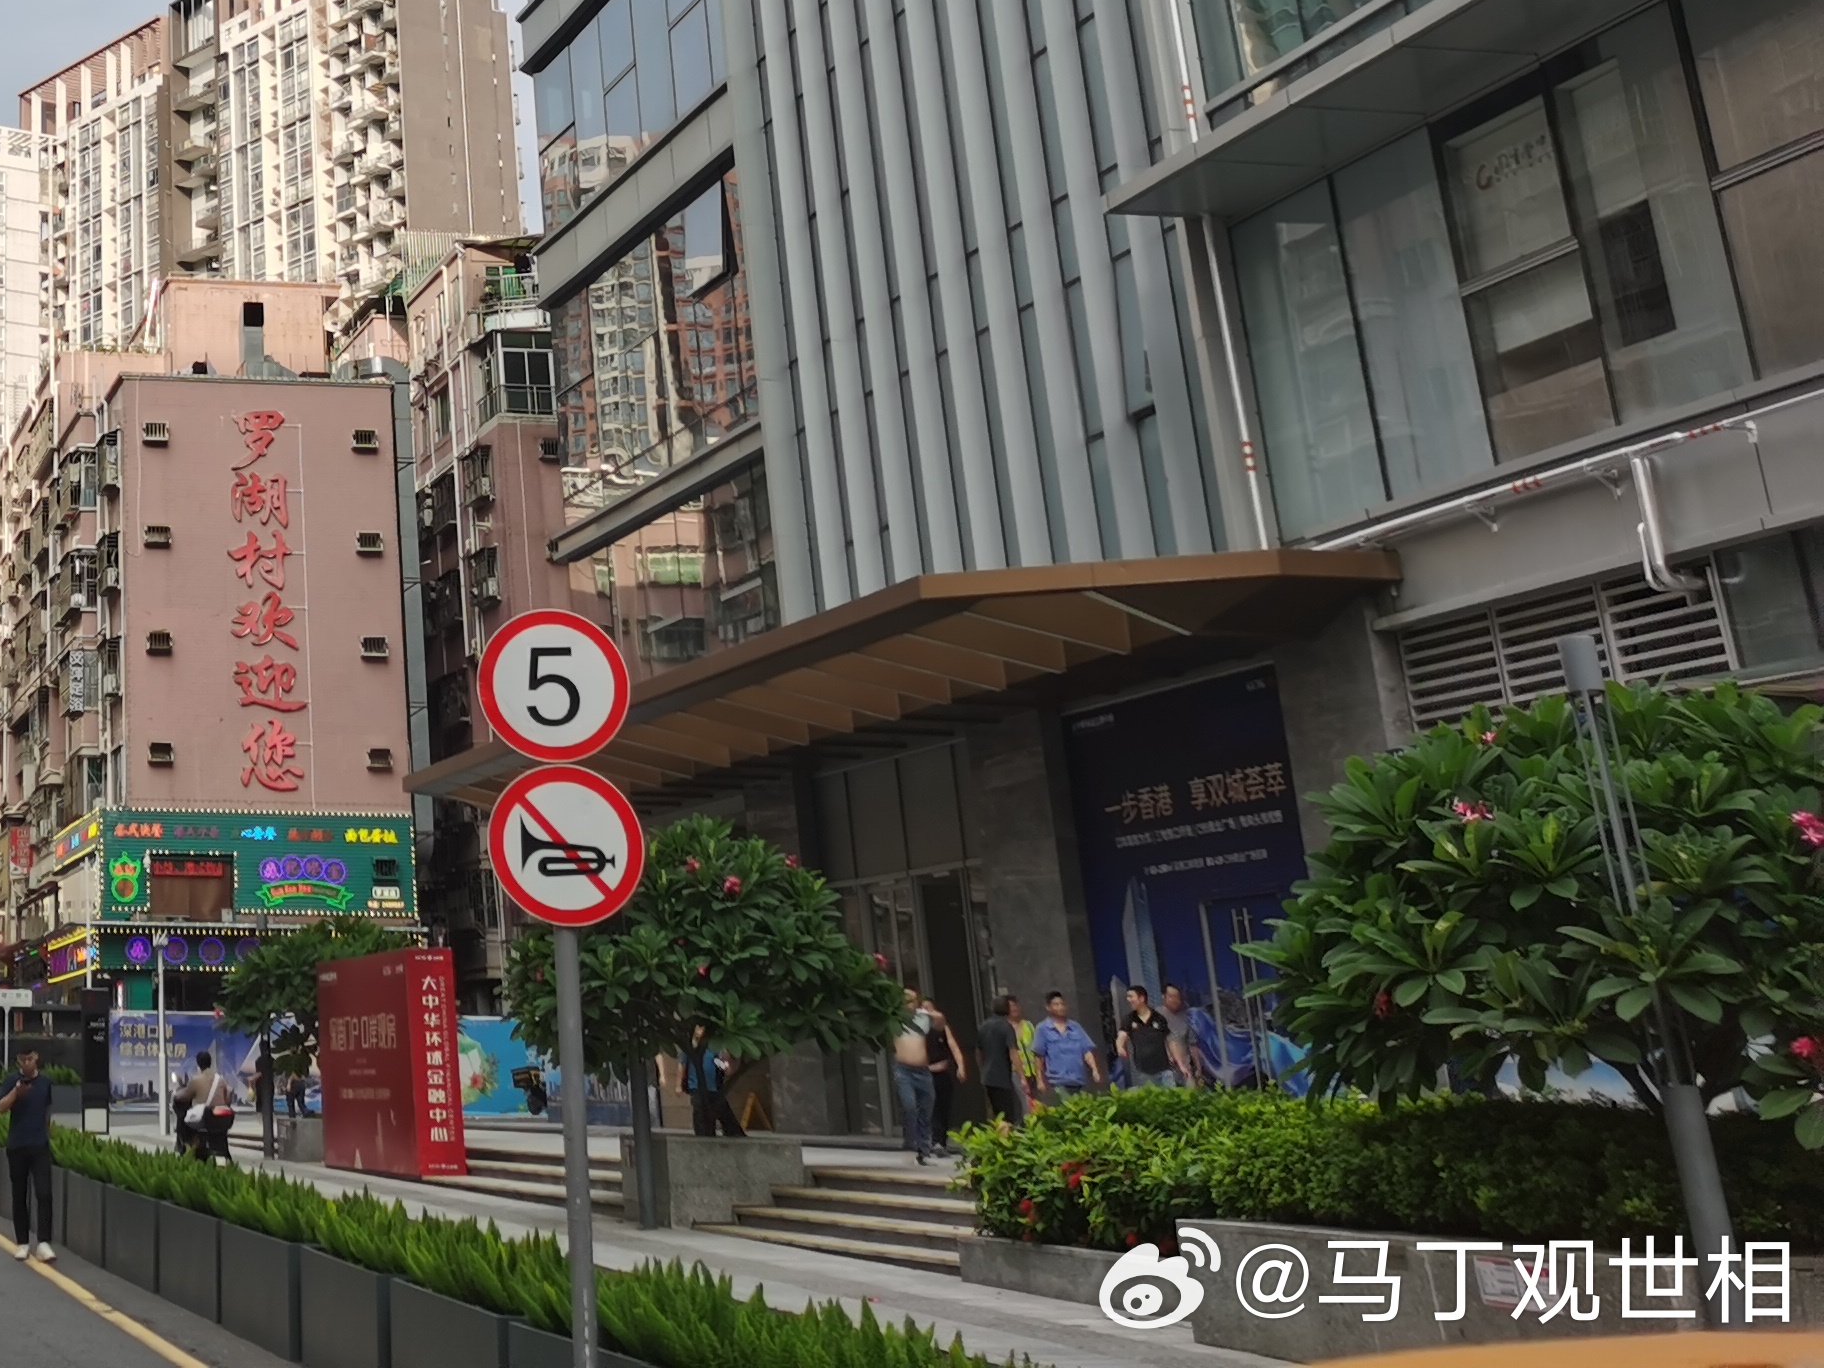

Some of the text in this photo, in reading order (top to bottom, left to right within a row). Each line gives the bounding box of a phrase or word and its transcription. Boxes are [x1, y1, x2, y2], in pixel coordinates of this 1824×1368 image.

[228, 409, 307, 792] 罗湖村欢迎您
[526, 646, 580, 727] 5
[1104, 761, 1287, 825] 一步香港 享双城荟萃
[421, 974, 449, 1143] 大中华环球金融中心
